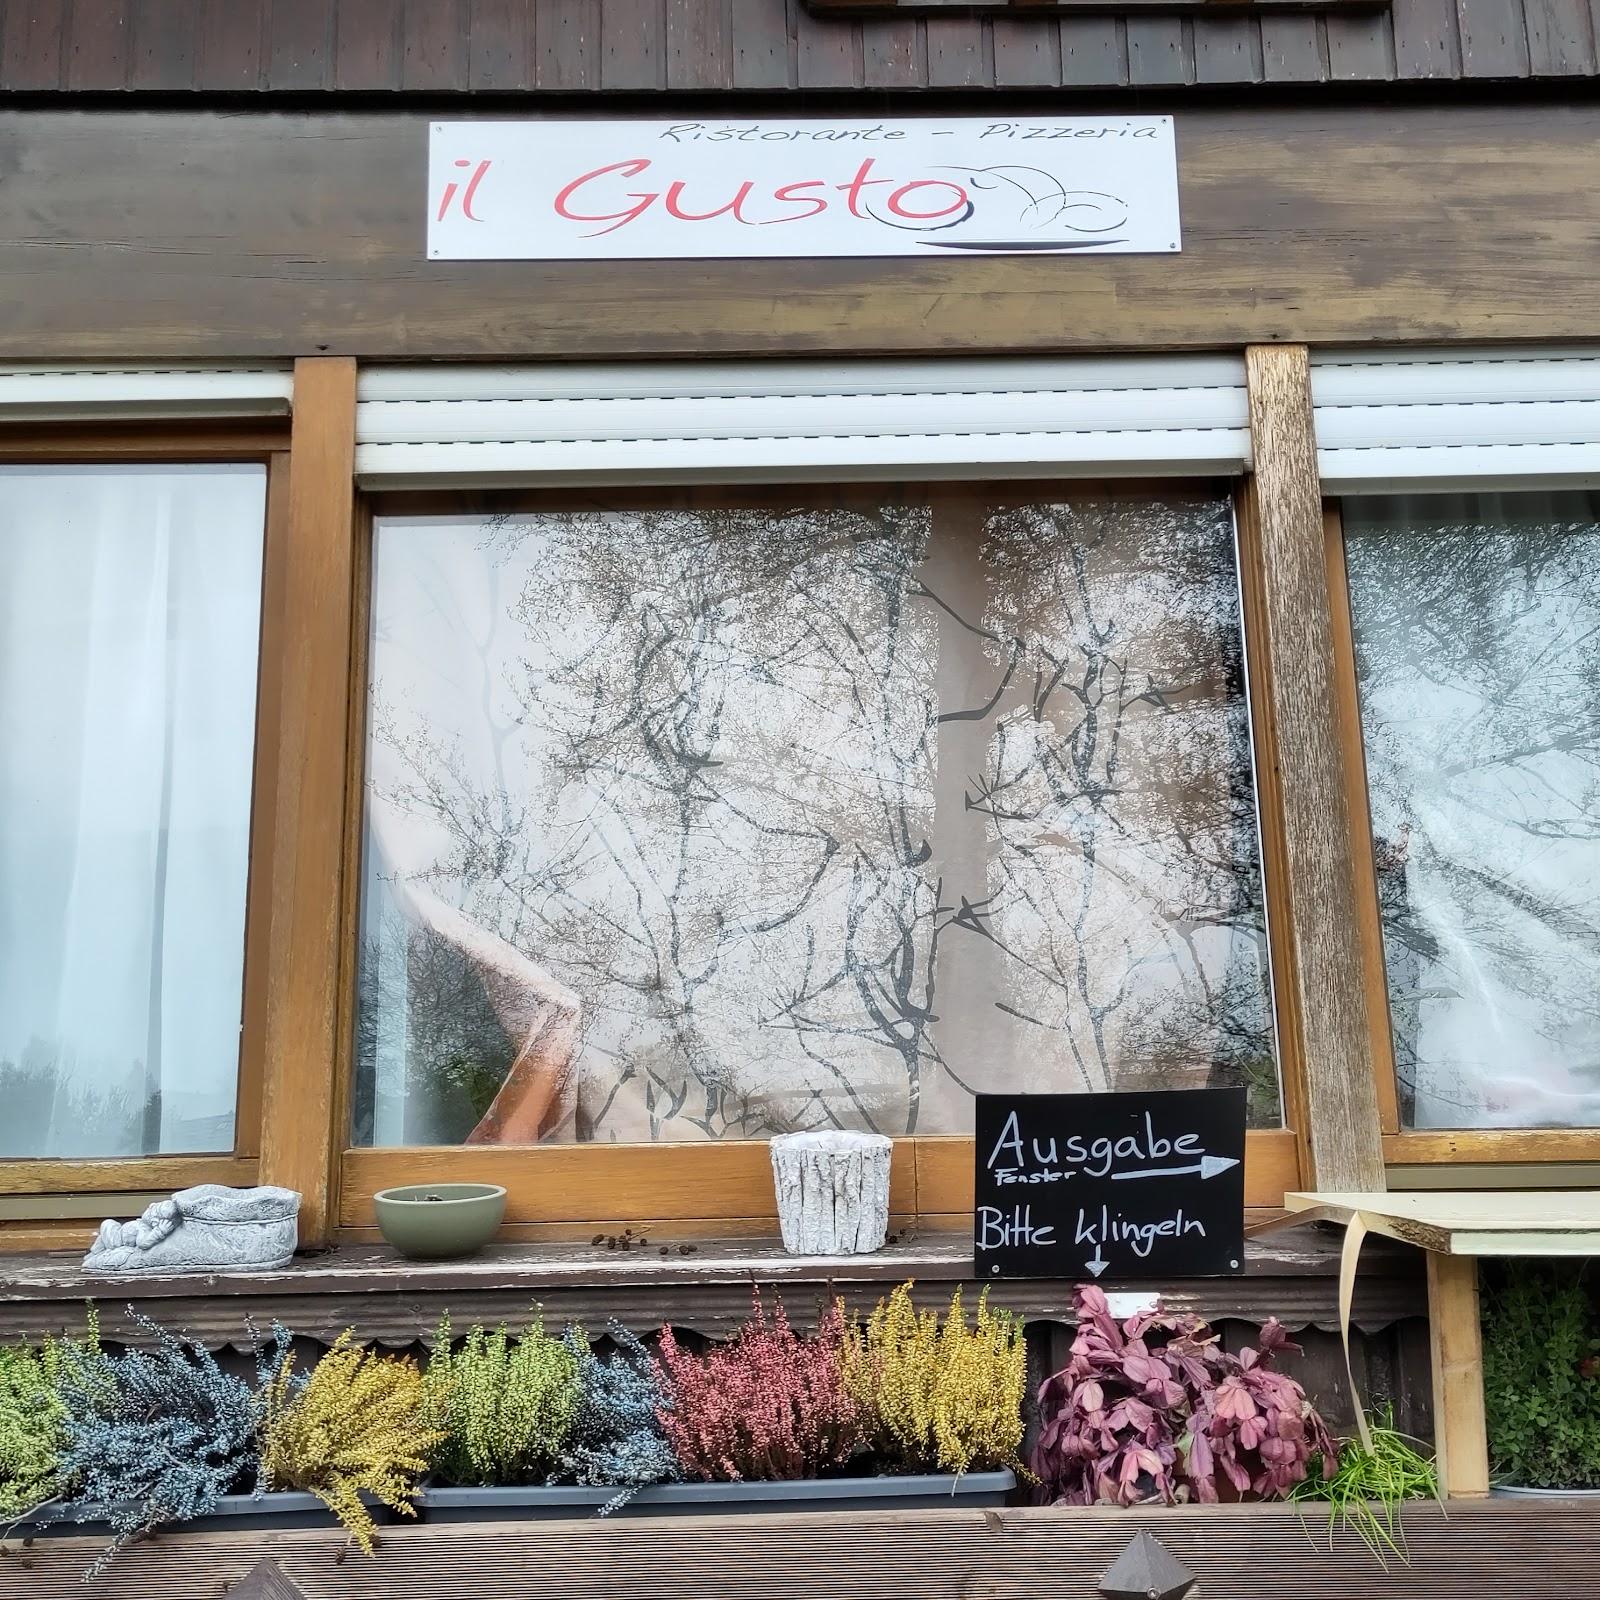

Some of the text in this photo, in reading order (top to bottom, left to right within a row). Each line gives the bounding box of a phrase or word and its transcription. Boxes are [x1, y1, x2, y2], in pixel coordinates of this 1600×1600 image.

[659, 123, 907, 142] Ristorante
[979, 122, 1158, 140] Pizzeria
[437, 158, 969, 238] il Gusto
[987, 1110, 1206, 1177] Ausgabe
[994, 1167, 1077, 1186] Fenster
[976, 1204, 1057, 1251] Bitte
